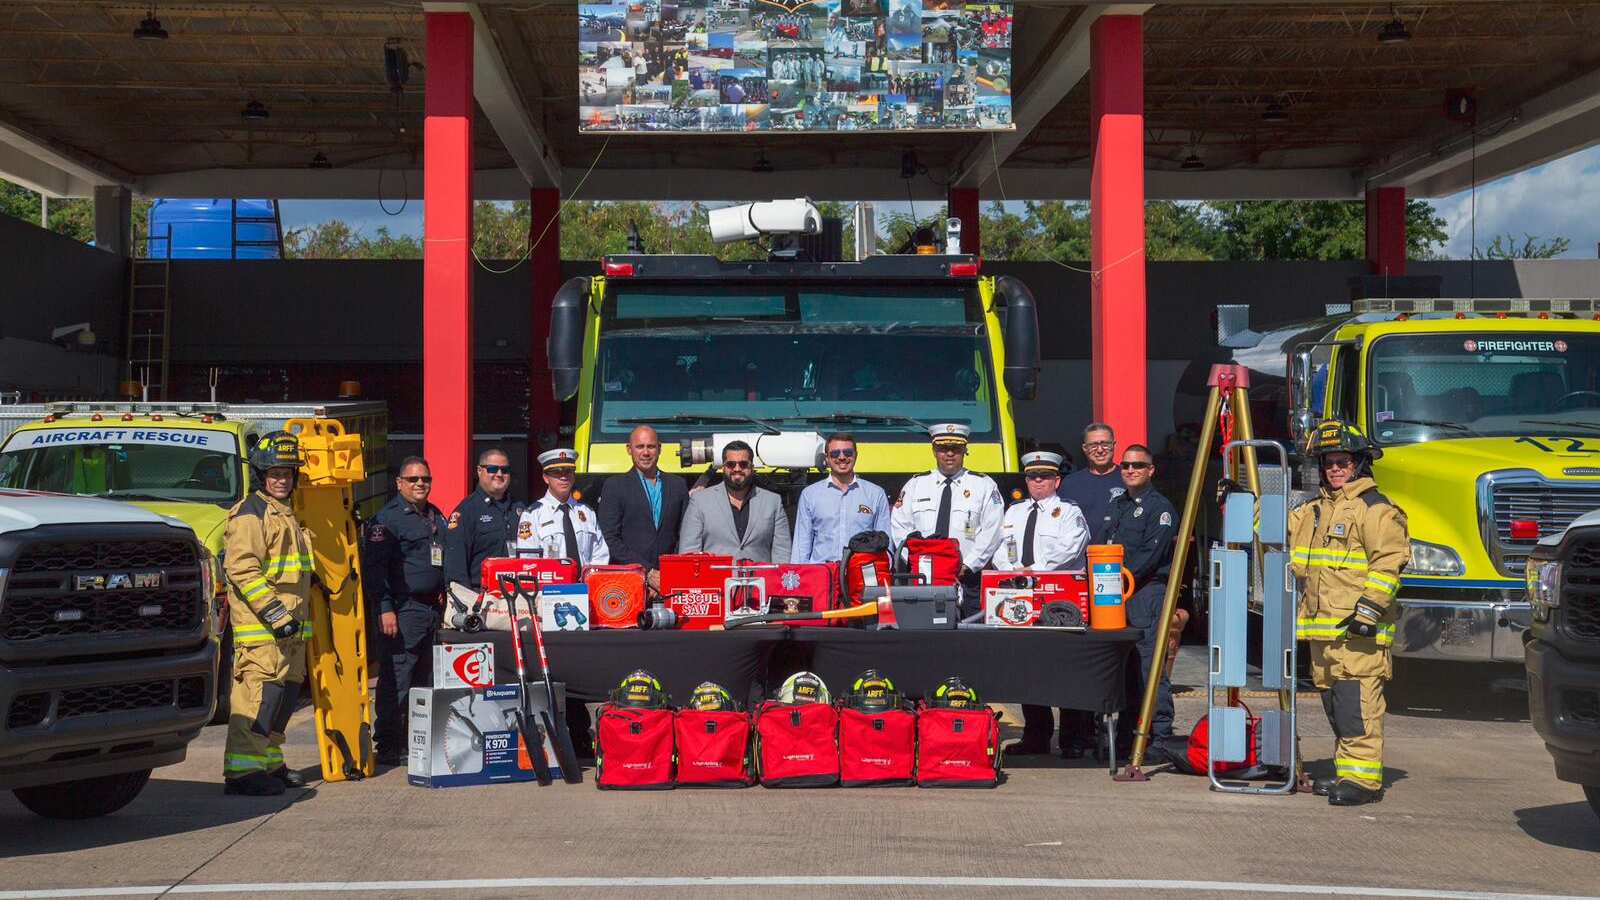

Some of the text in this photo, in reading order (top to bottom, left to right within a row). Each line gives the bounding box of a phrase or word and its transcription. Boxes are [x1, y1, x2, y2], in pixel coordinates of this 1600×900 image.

[1477, 341, 1555, 352] FIREFIGHTER
[32, 430, 209, 447] AIRCRAFT RESCUE
[1514, 437, 1600, 452] 12
[75, 574, 161, 591] RAM
[672, 592, 720, 604] RESCUE
[682, 603, 710, 616] SAW
[630, 685, 648, 694] ARFF
[798, 686, 816, 696] ARFF
[867, 689, 885, 698] ARFF
[485, 738, 508, 750] K 970
